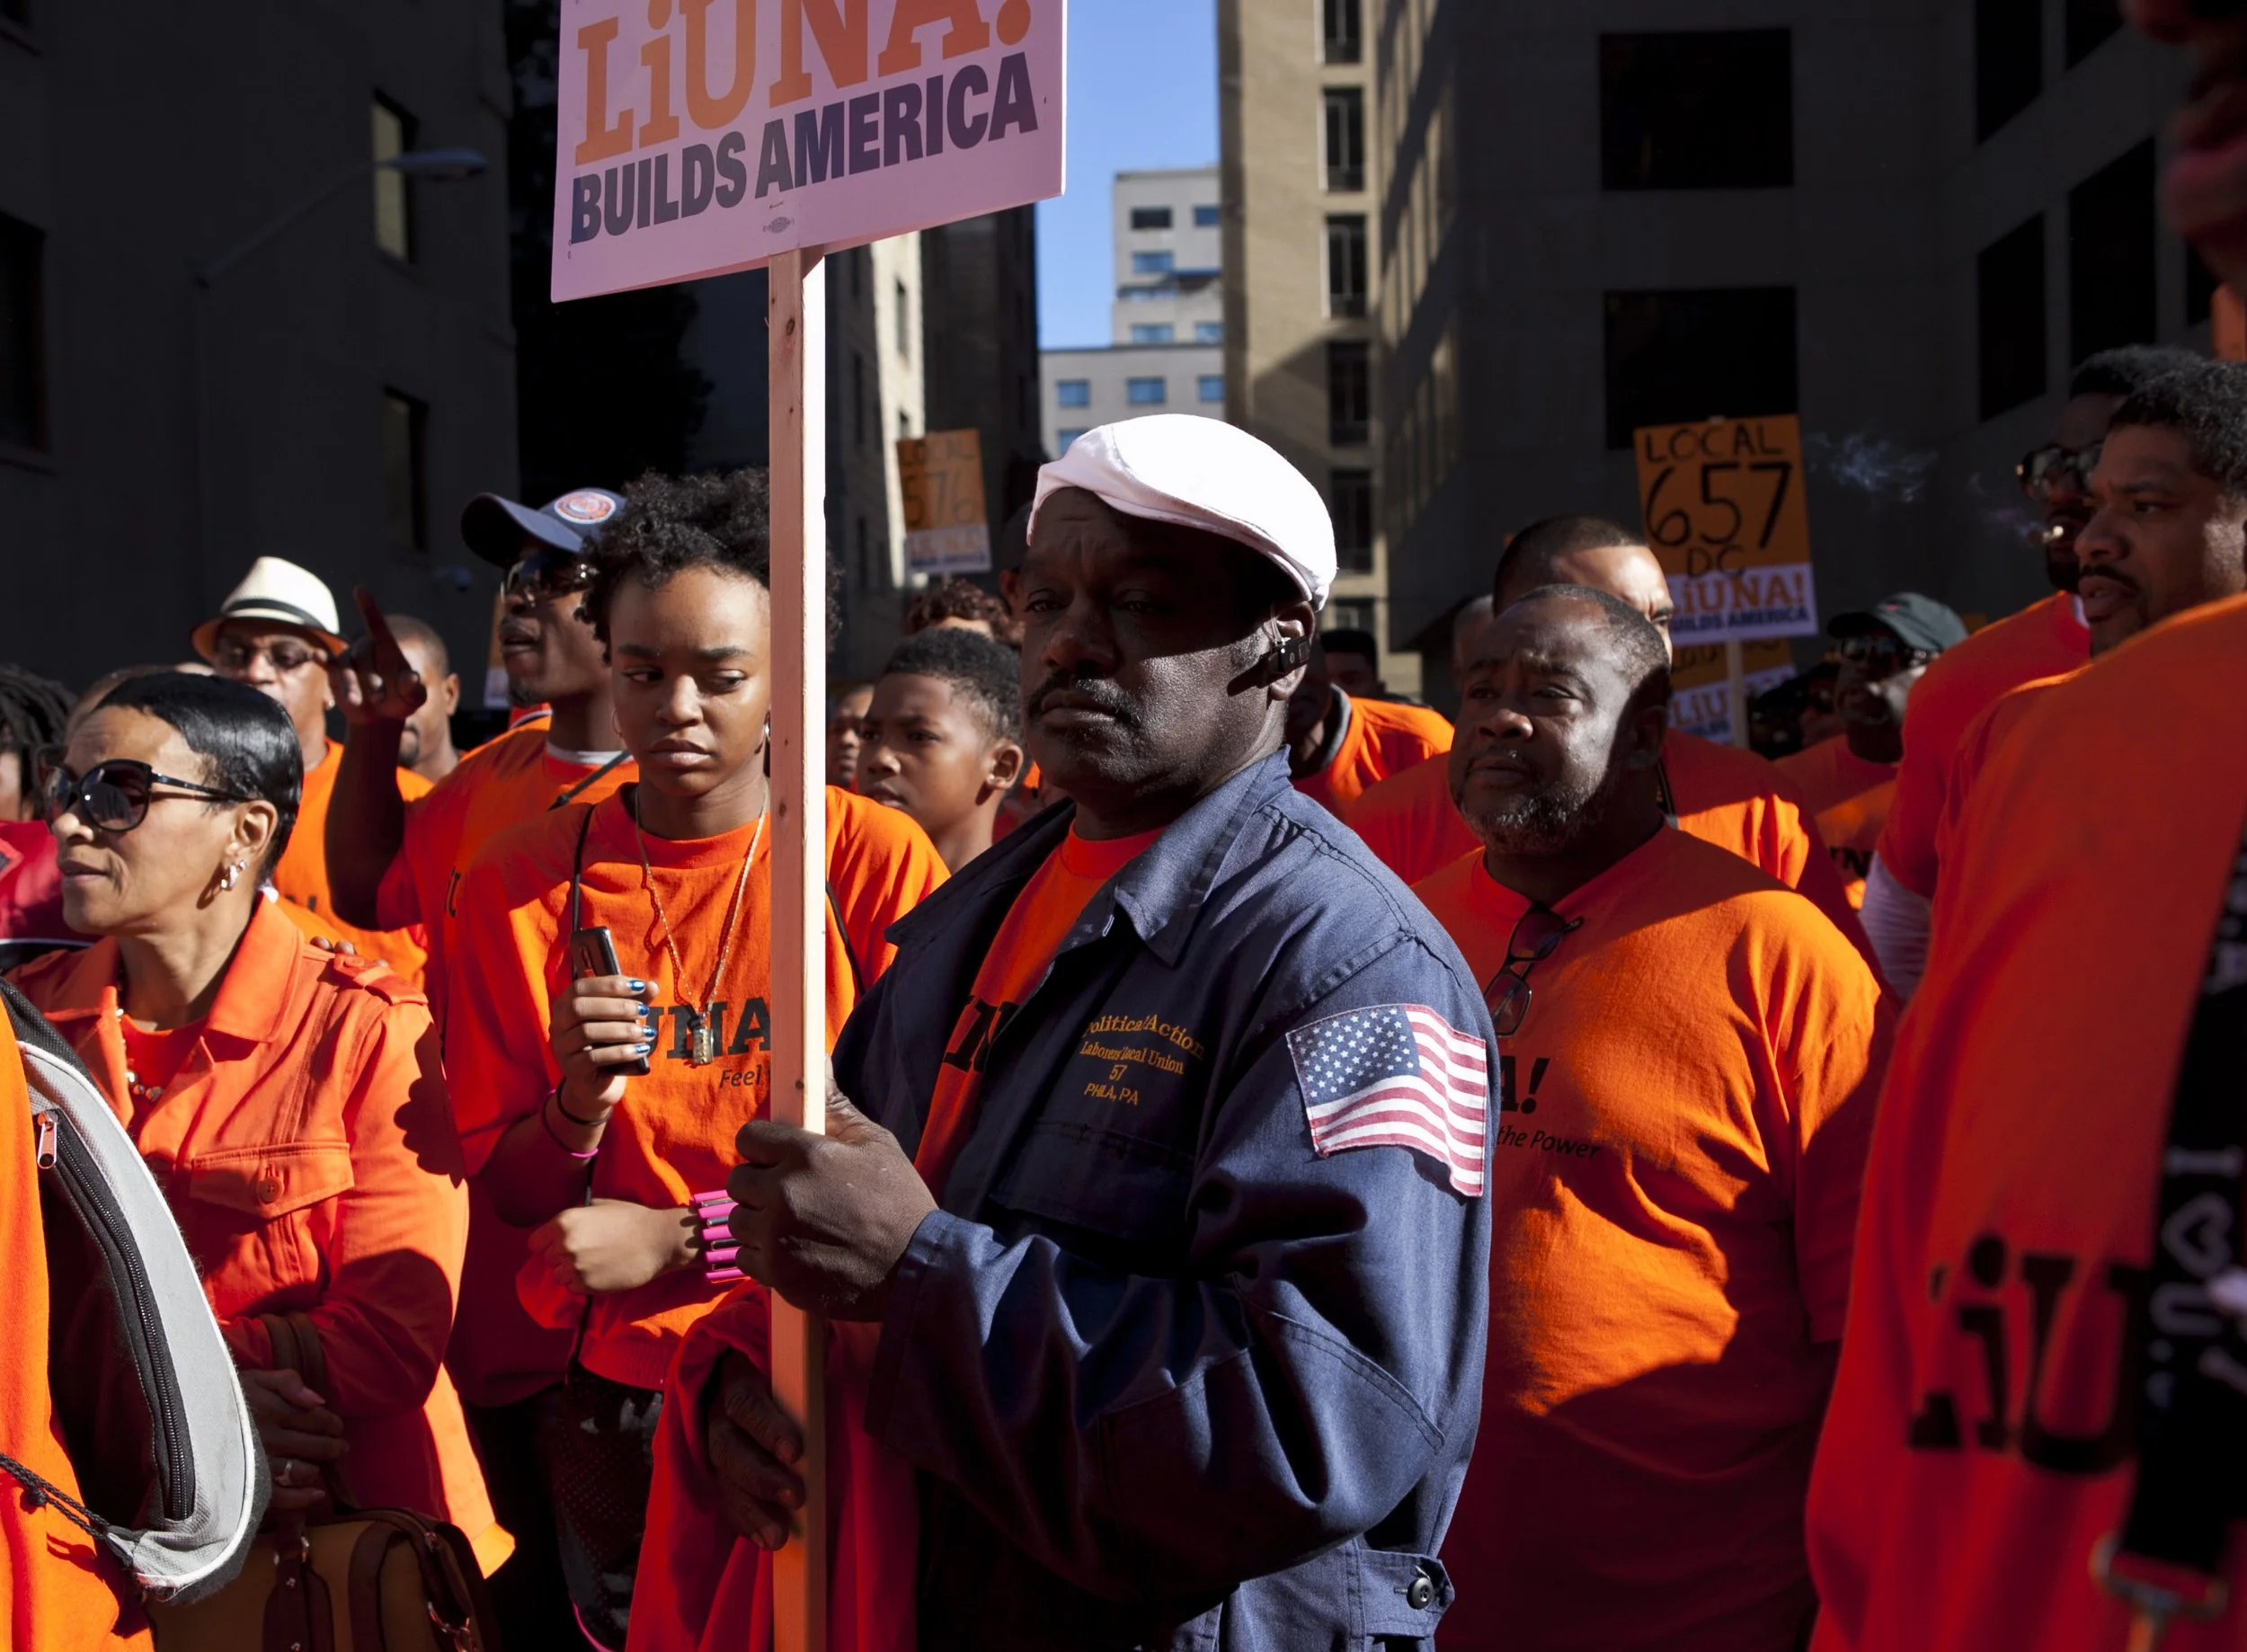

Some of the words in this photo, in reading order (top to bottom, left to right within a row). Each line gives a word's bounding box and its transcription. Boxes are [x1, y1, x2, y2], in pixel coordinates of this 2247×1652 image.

[575, 0, 1032, 166] LiUNA
[570, 130, 747, 244] BUILDS
[754, 51, 1038, 199] AMERICA
[1645, 422, 1782, 465] LOCAL
[1645, 460, 1792, 550] 657
[1686, 543, 1746, 579] DC
[1673, 572, 1804, 616] iUNA!
[1673, 614, 1722, 634] UILDS
[1728, 606, 1809, 627] AMERICA
[719, 1063, 763, 1088] Feel
[1108, 1063, 1129, 1081] 57
[1147, 1049, 1185, 1075] Union
[1117, 1086, 1140, 1106] PA
[1497, 1125, 1528, 1147] the
[1530, 1130, 1602, 1160] Power
